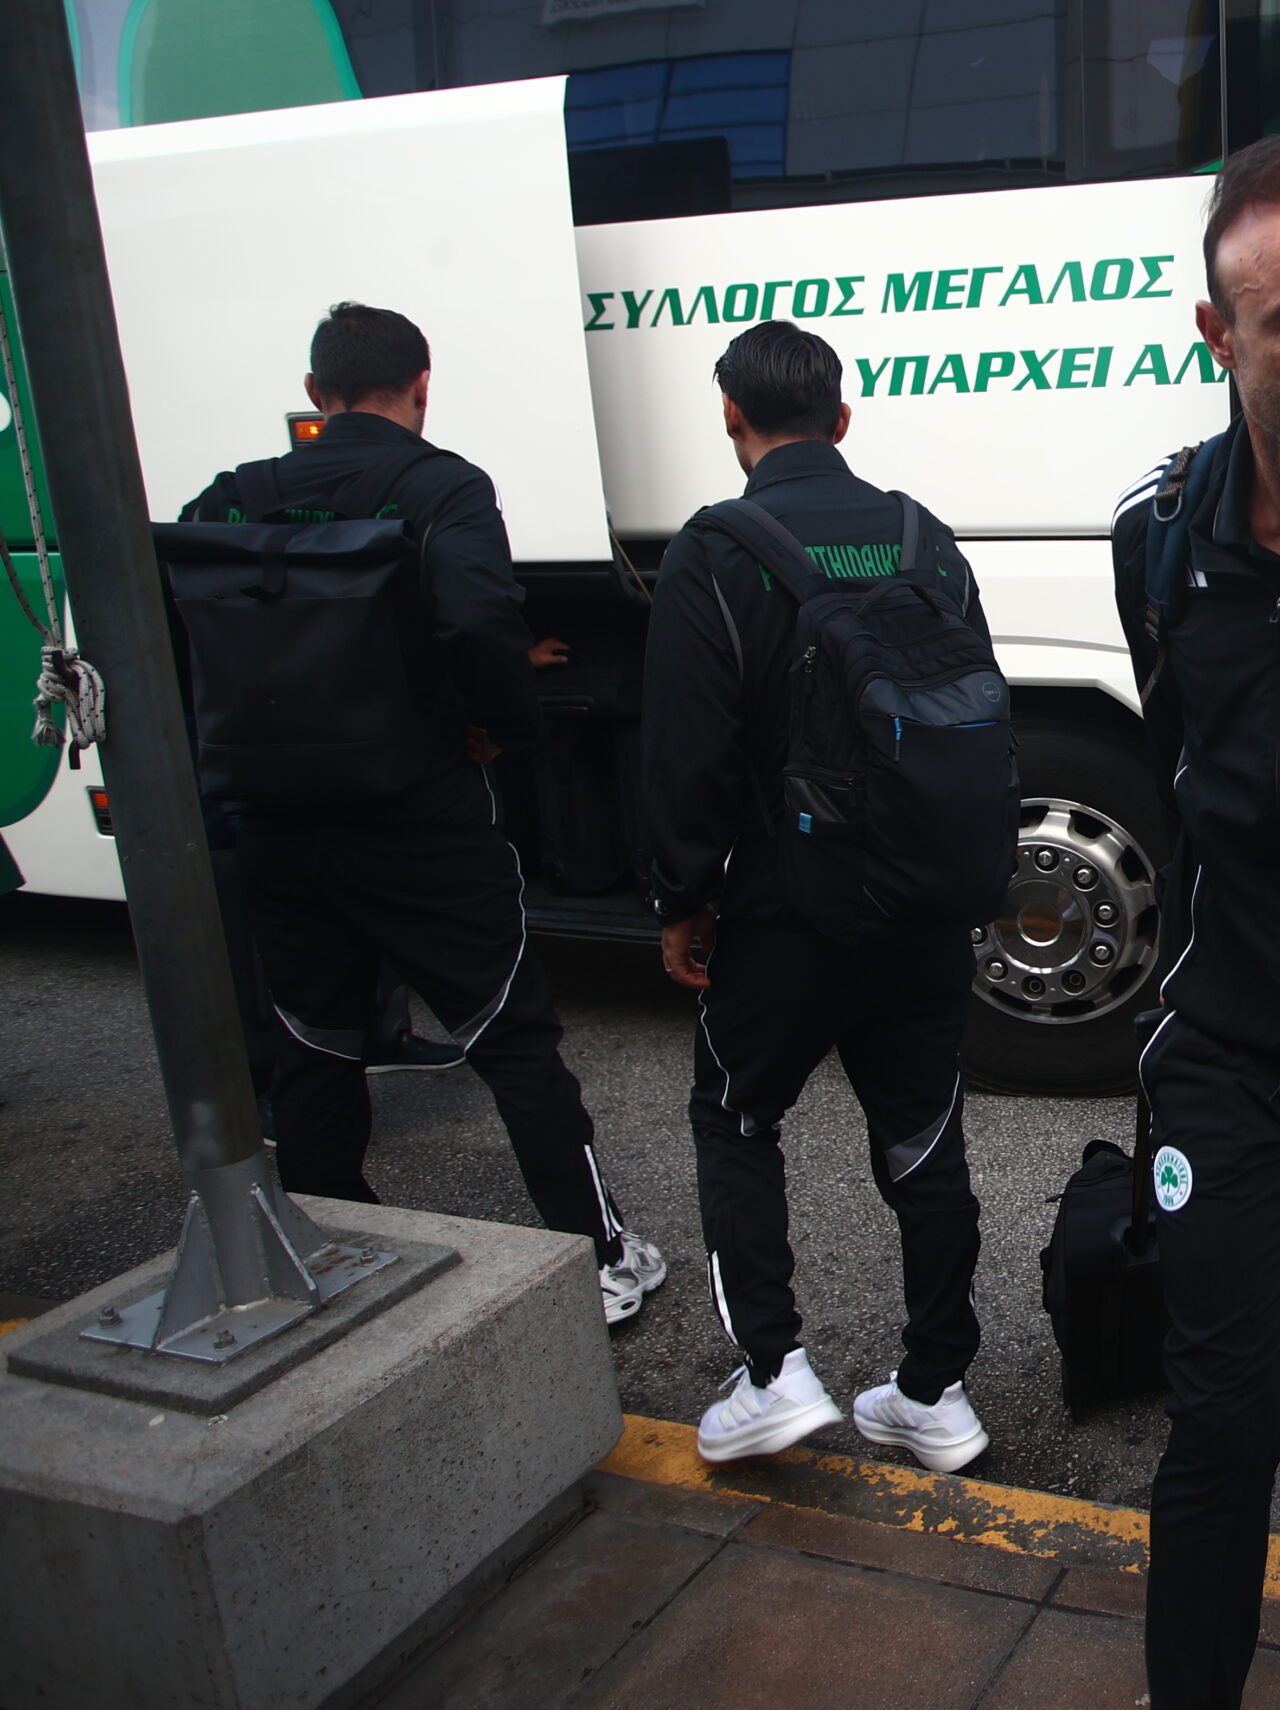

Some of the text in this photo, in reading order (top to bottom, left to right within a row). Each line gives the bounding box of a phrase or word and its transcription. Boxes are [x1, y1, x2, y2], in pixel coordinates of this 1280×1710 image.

[584, 254, 1175, 332] ΣΥΛΛΟΓΟΣ ΜΕΓΑΛΟΣ
[854, 346, 1115, 398] ΥΠΑΡΧΕΙ
